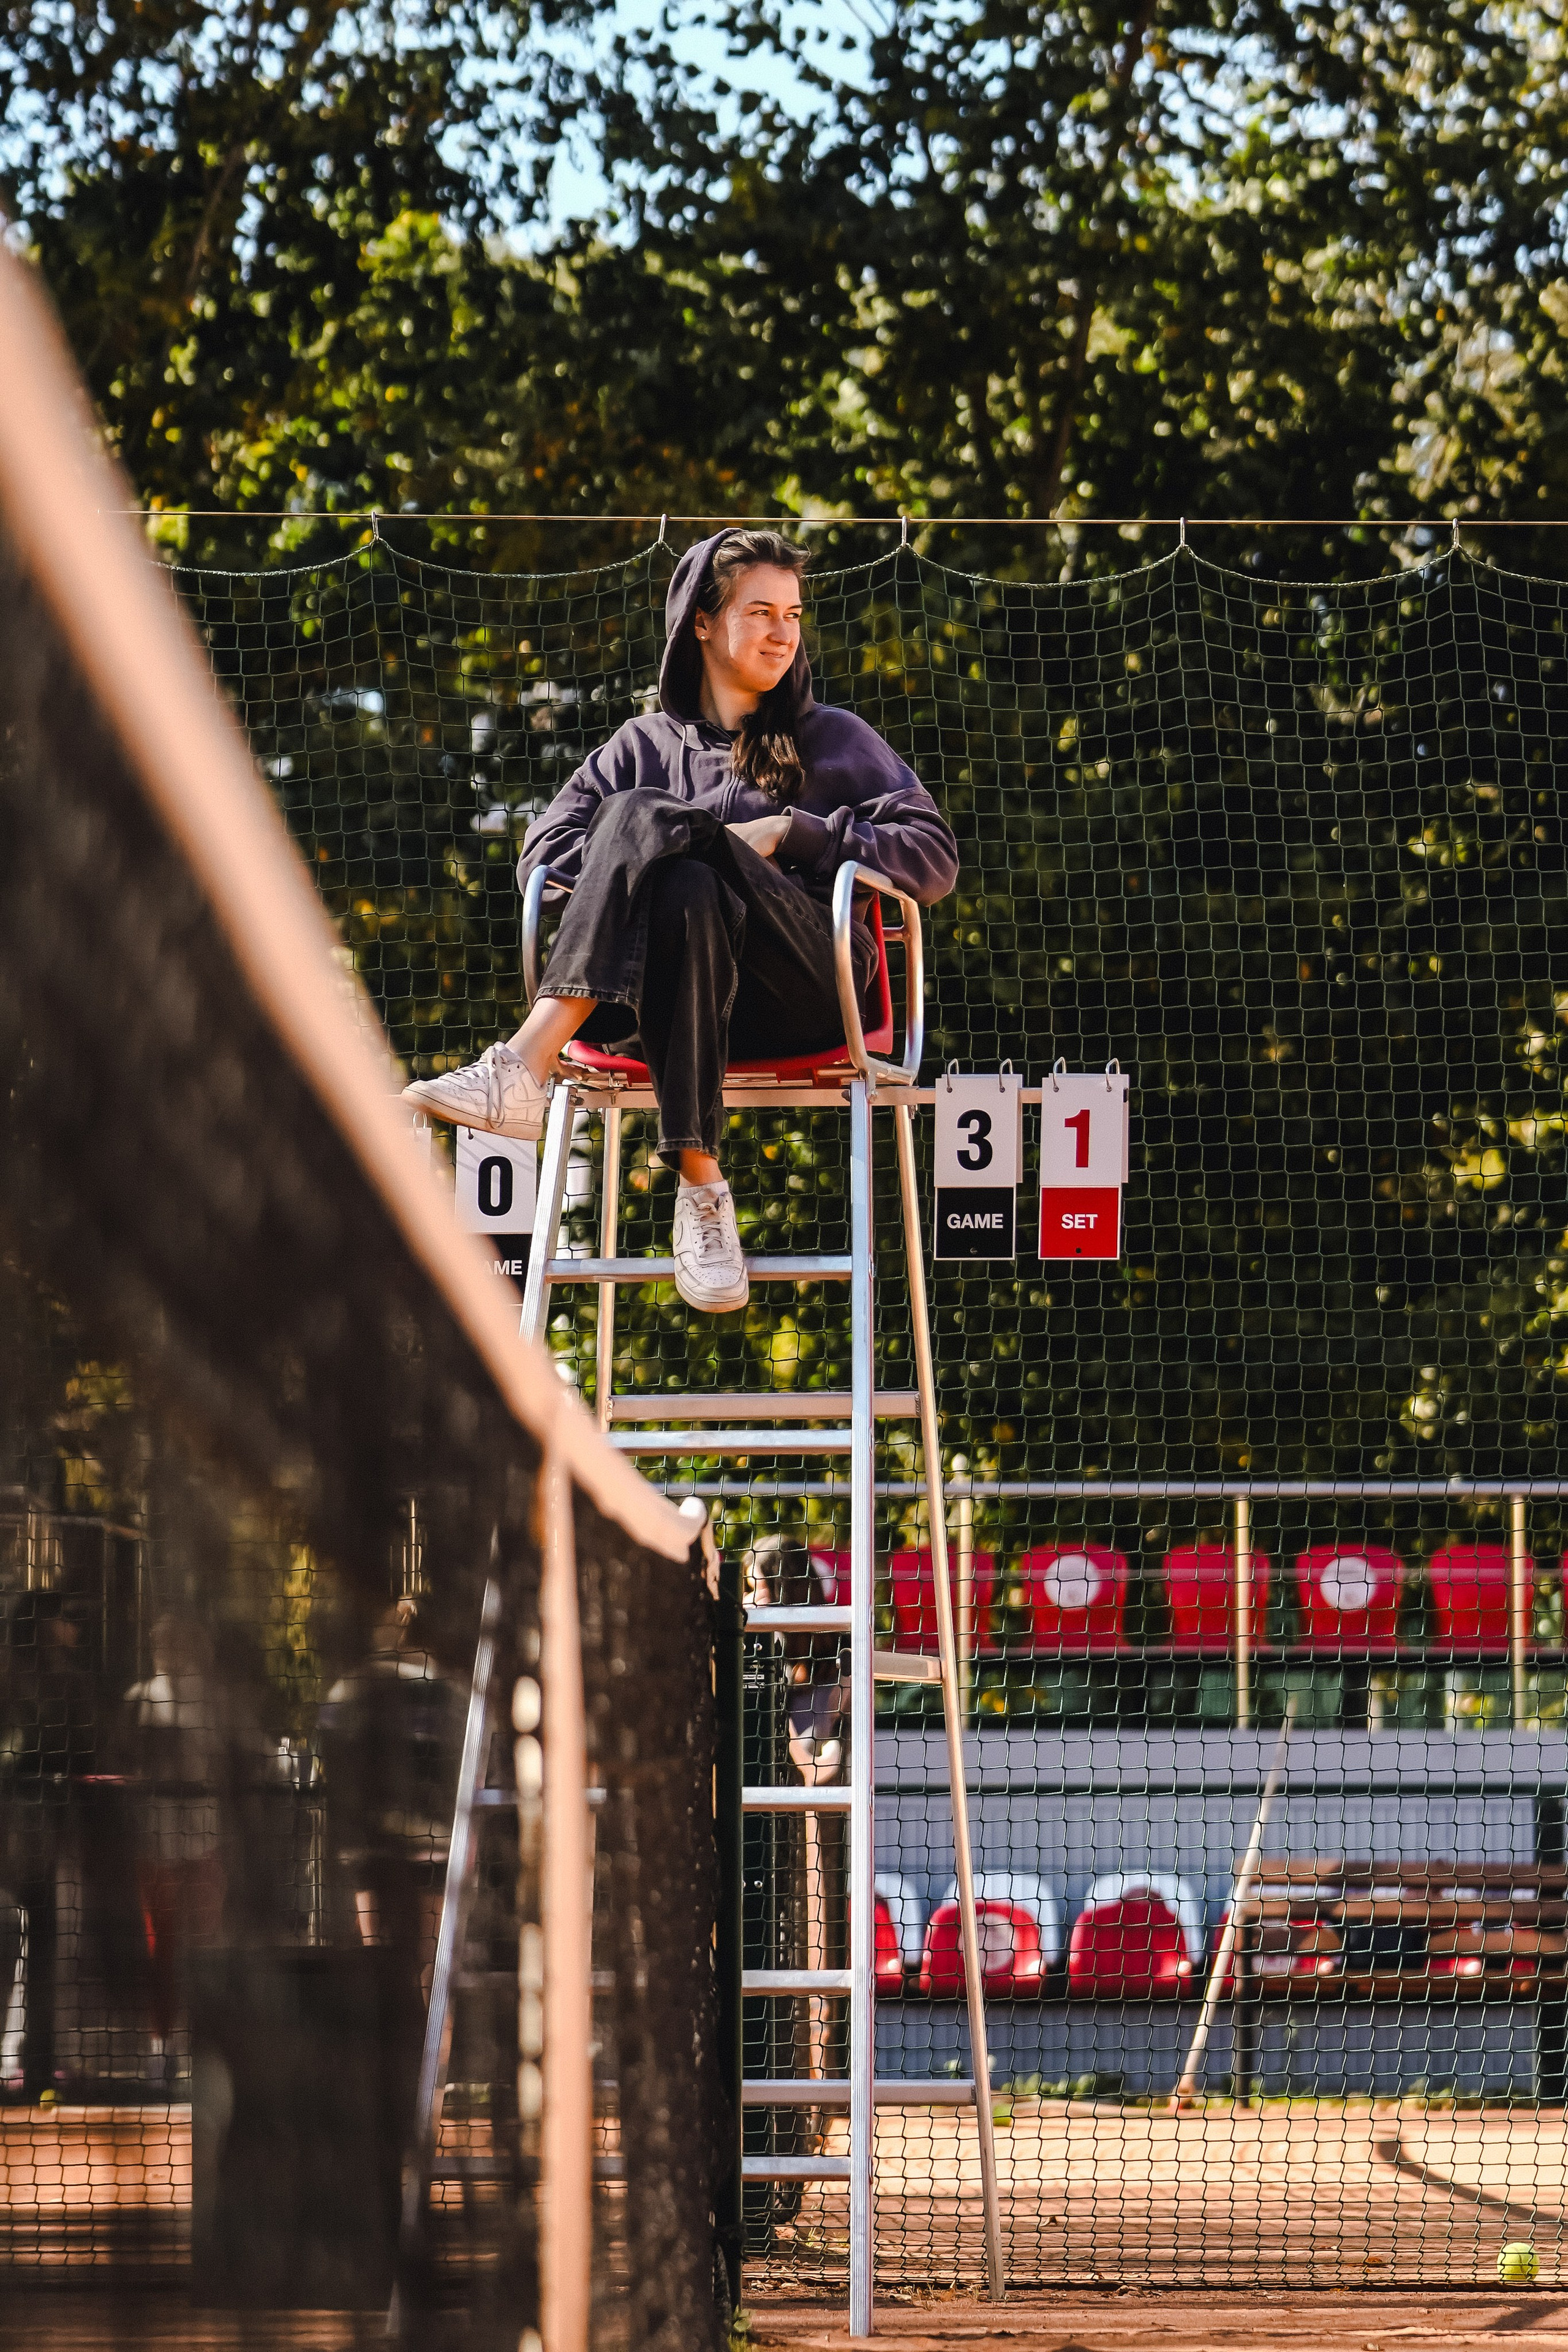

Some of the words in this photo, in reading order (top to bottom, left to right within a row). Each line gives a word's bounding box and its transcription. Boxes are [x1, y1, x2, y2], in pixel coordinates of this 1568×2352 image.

[957, 1109, 993, 1170] 3
[1065, 1109, 1090, 1168] 1
[478, 1156, 513, 1216] 0
[947, 1213, 1003, 1229] GAME
[1061, 1213, 1098, 1229] SET
